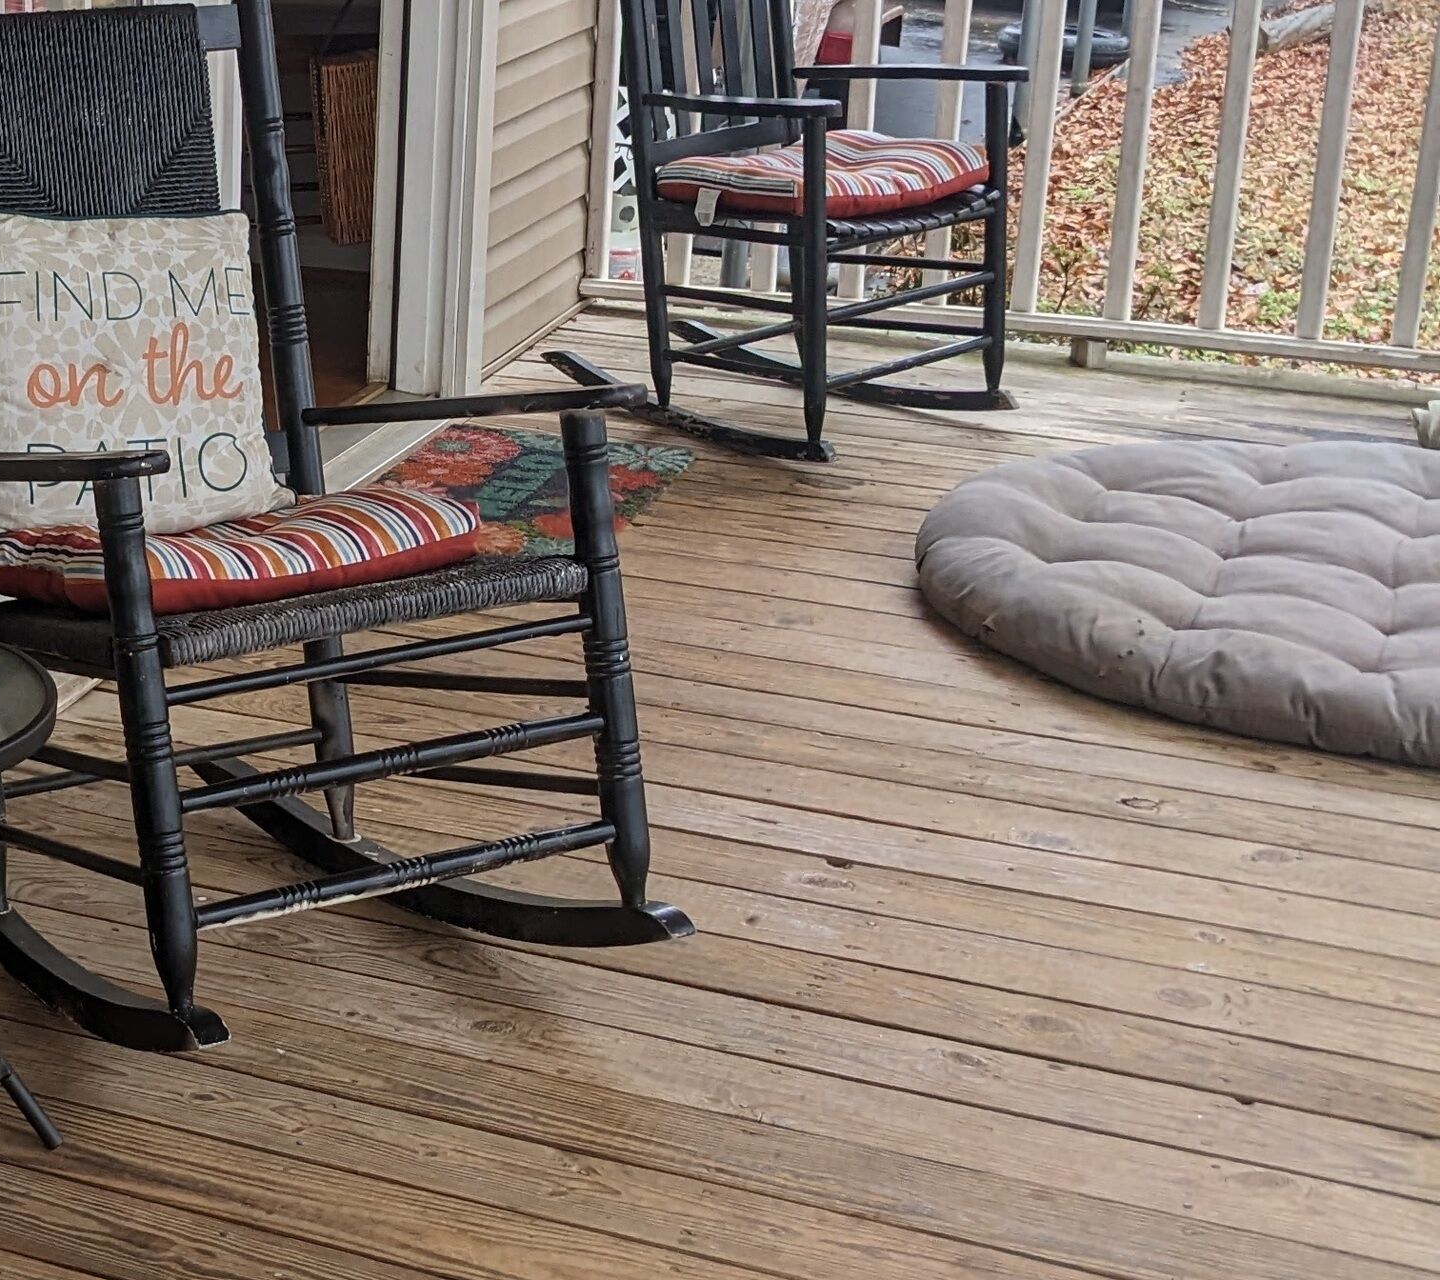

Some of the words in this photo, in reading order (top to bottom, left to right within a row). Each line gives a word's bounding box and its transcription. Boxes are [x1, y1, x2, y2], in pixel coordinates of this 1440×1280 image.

[168, 267, 251, 318] ME
[27, 363, 125, 409] on
[142, 320, 244, 407] the
